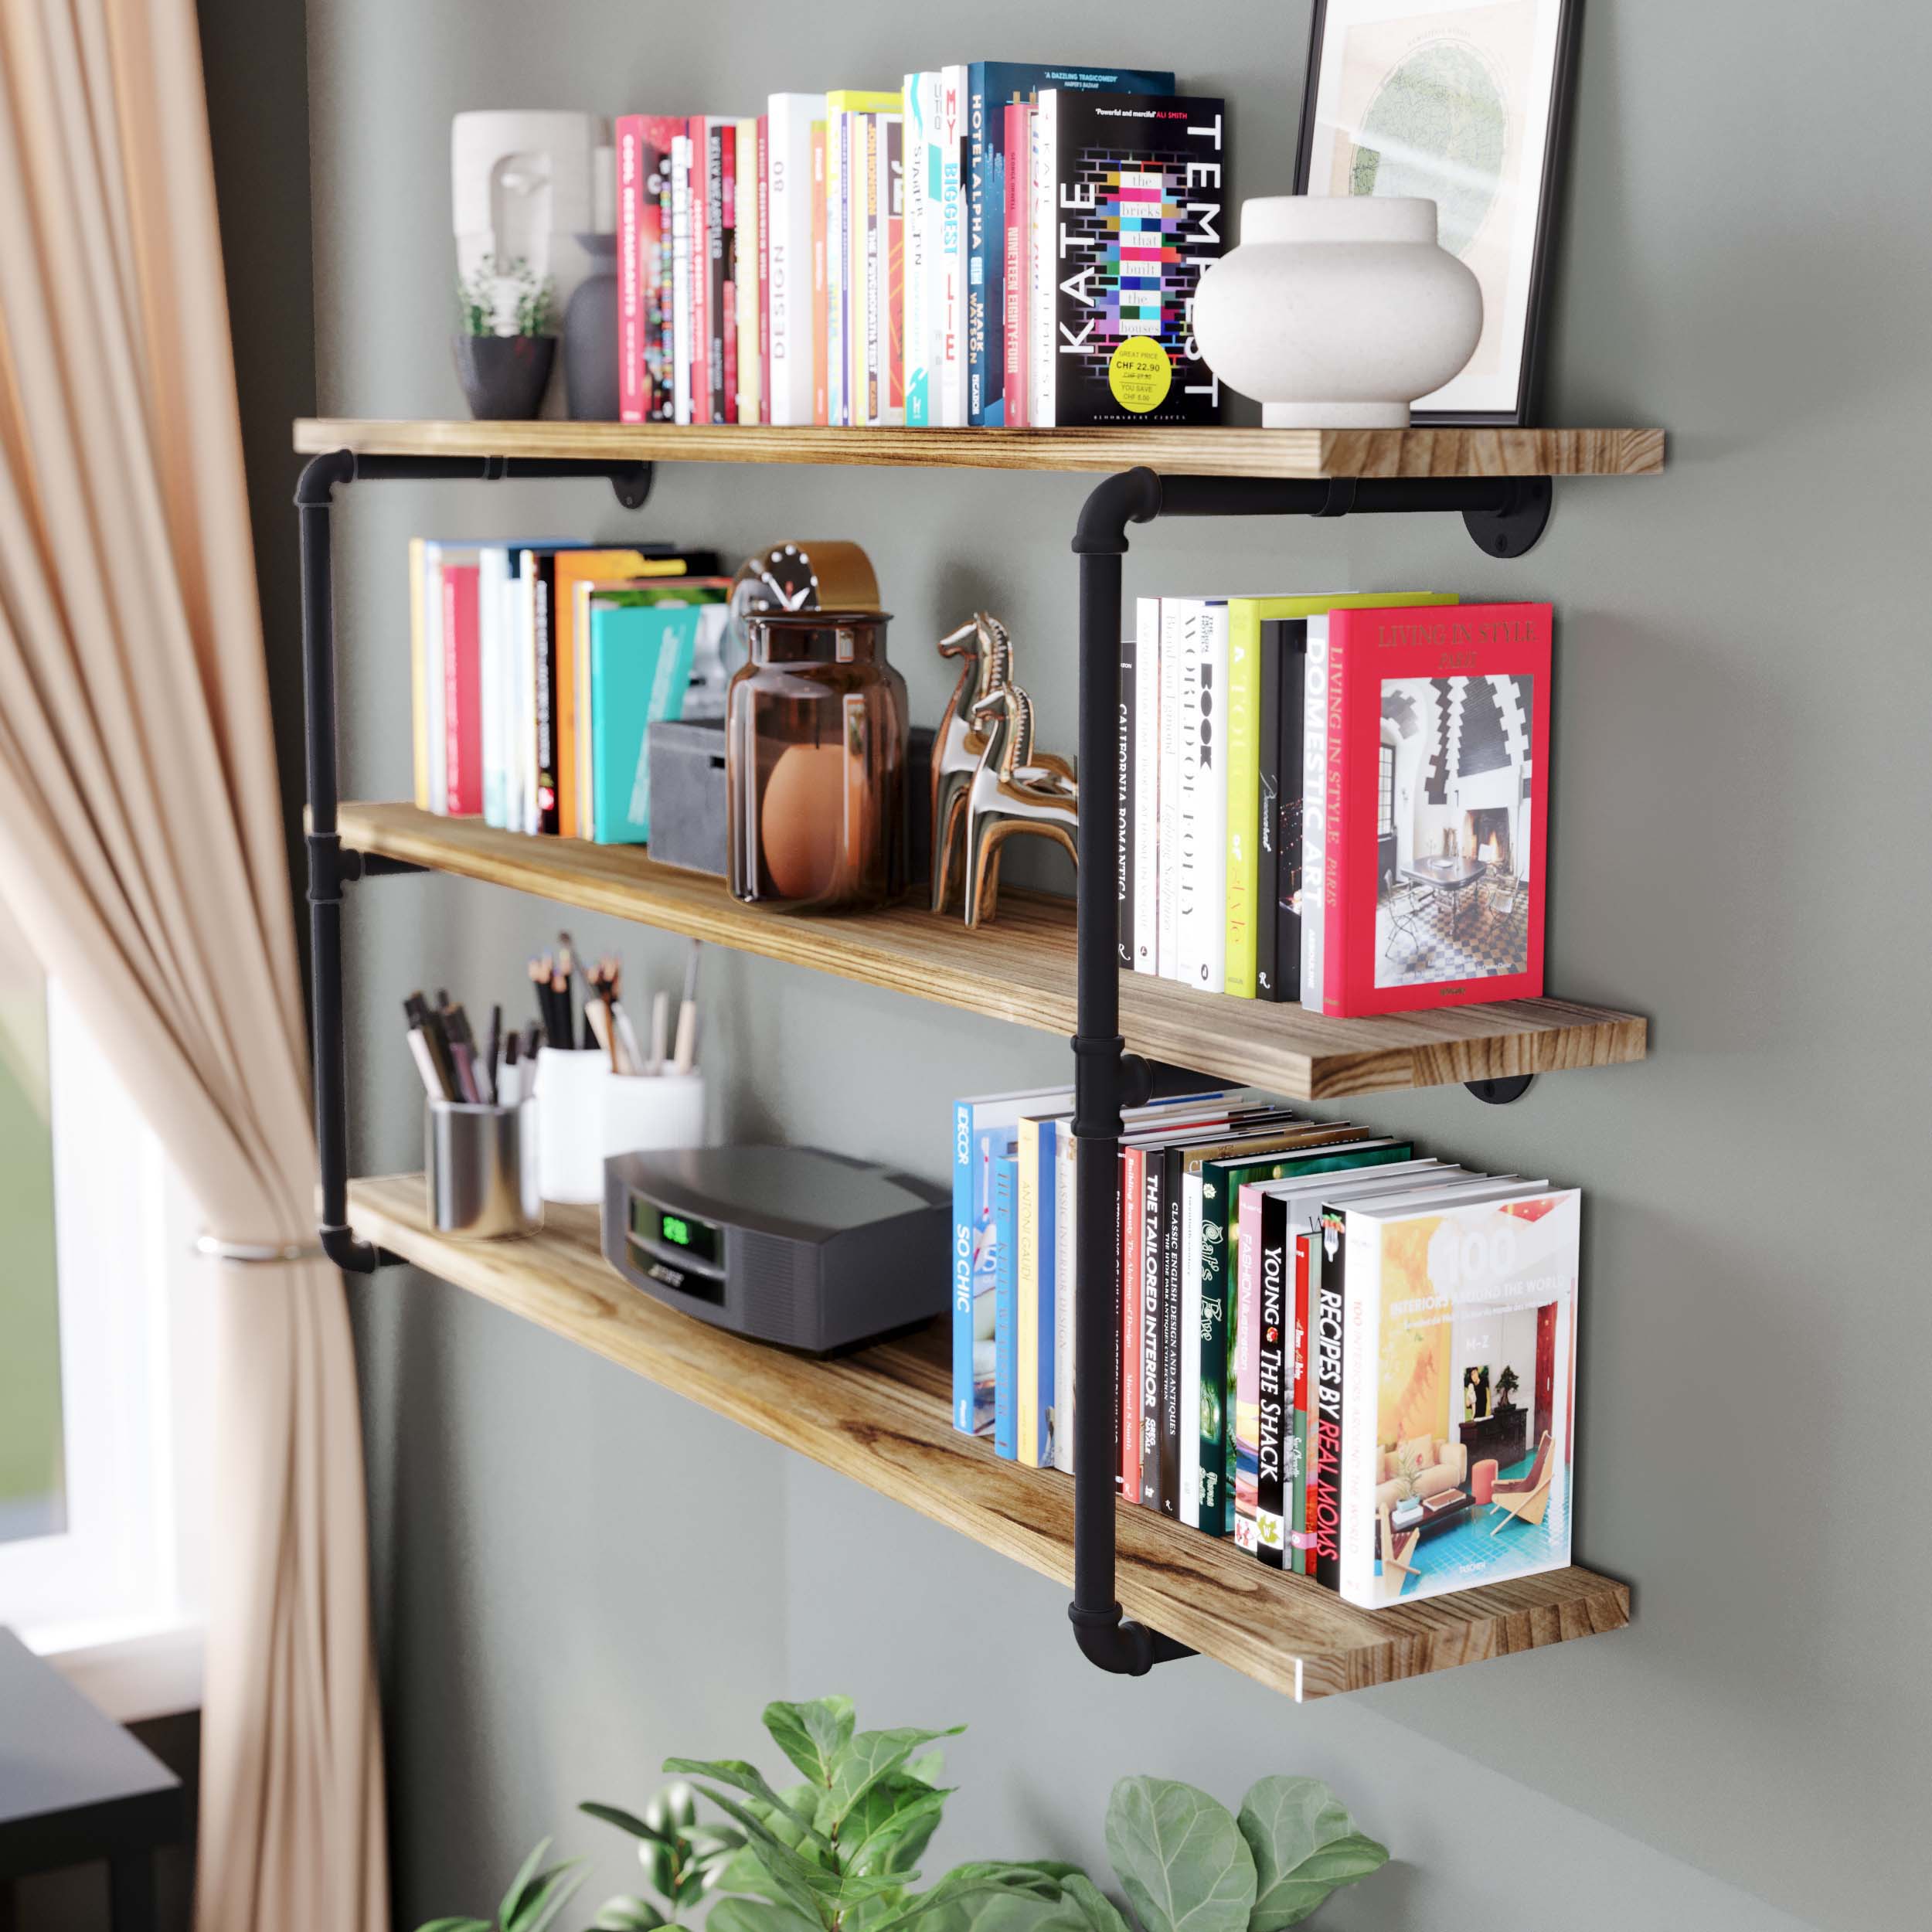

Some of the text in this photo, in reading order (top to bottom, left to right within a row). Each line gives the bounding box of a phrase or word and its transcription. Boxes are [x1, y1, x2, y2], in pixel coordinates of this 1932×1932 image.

[1052, 72, 1078, 80] DAZZLING
[971, 94, 982, 168] HOTEL
[944, 163, 957, 256] BIGGEST
[1121, 203, 1161, 218] bricks
[1132, 175, 1152, 186] the
[971, 173, 982, 250] ALPHA
[1132, 233, 1158, 247] that
[1059, 182, 1096, 354] KATE
[1125, 262, 1155, 276] built
[1128, 292, 1148, 304] the
[1008, 226, 1019, 374] NINETEEN EIGHTY-FOUR
[1121, 321, 1160, 334] houses
[1119, 351, 1140, 359] GREAT
[1137, 363, 1161, 372] 22.90
[1121, 384, 1134, 393] YOU
[1378, 619, 1539, 648] LIVING IN STYLE
[1200, 663, 1213, 770] BOOK
[1304, 638, 1326, 909] DOMESTIC ART
[1325, 646, 1343, 908] LIVING IN STYLE PARIS
[957, 1224, 971, 1313] SO CHIC
[1444, 1226, 1516, 1283] 100
[1145, 1175, 1158, 1406] THE TAILORED INTERIOR
[1390, 1295, 1449, 1317] INTERIORS
[1504, 1281, 1524, 1297] THE
[1526, 1274, 1566, 1291] WORLD
[1260, 1247, 1282, 1482] YOUNG THE SHACK
[1168, 1372, 1176, 1436] ANTIQUES
[1316, 1288, 1343, 1561] RECIPES BY REAL MOMS
